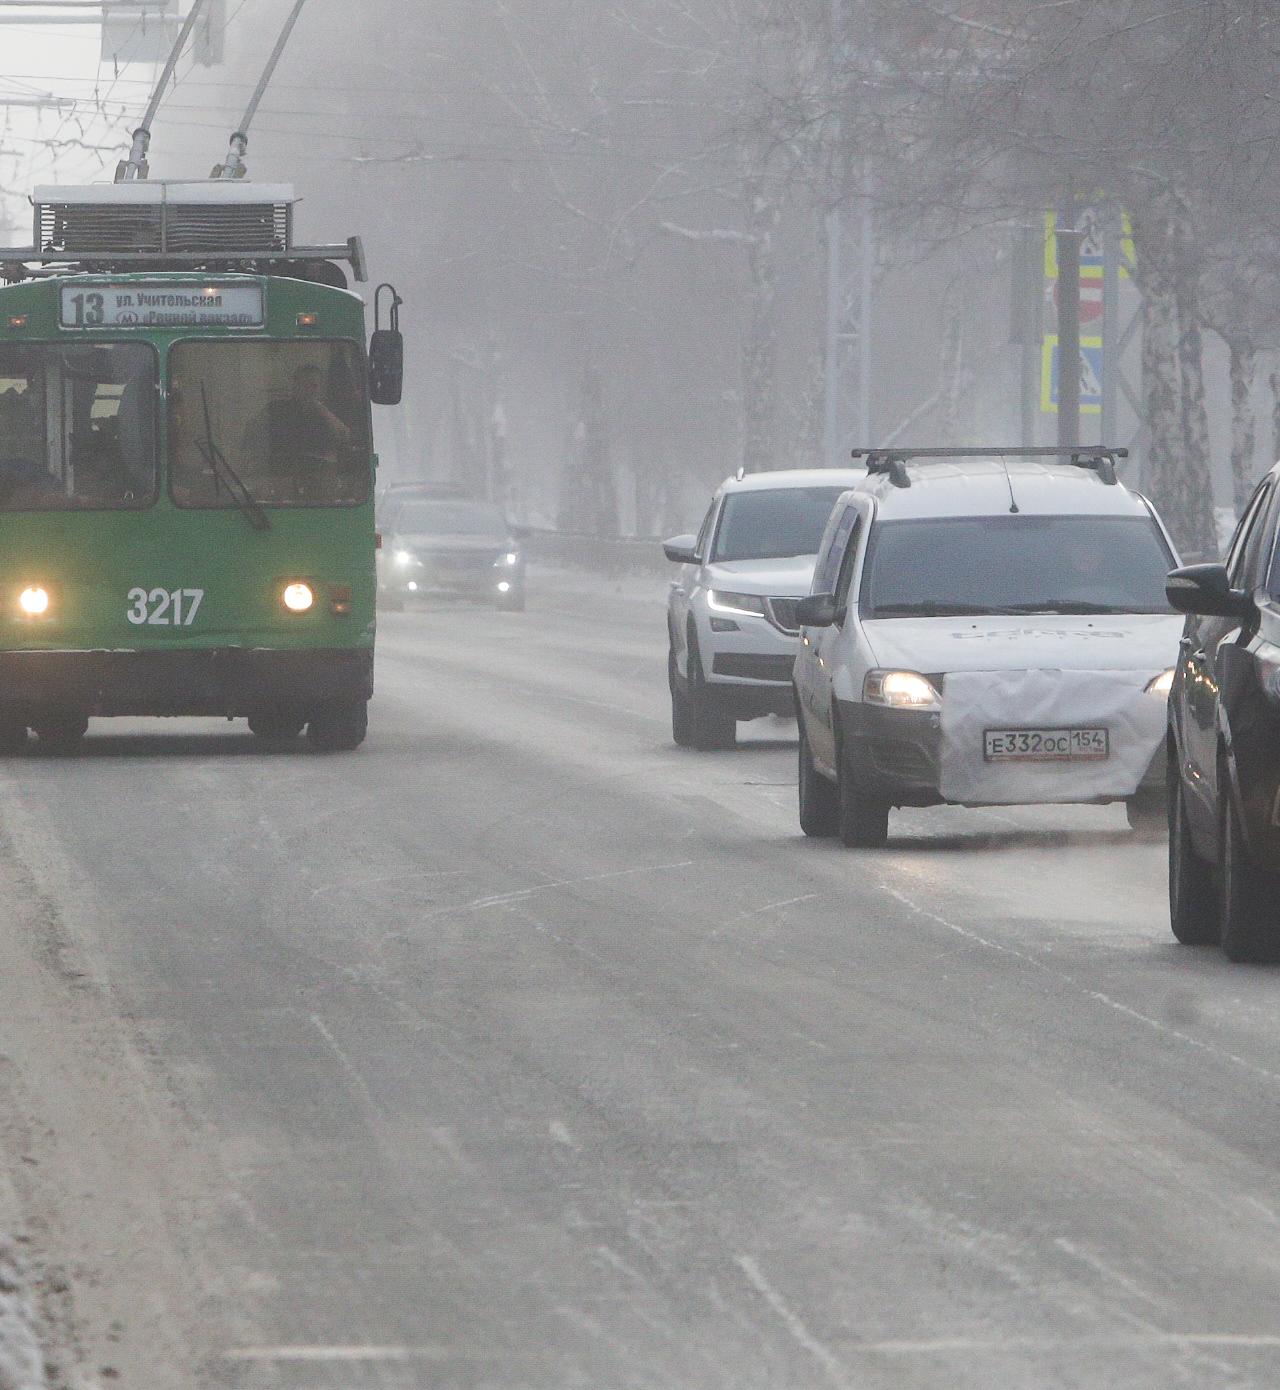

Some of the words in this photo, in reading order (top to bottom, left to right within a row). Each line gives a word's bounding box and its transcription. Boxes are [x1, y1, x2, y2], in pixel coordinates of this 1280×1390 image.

[70, 293, 105, 325] 13
[116, 295, 134, 308] ул.
[137, 293, 223, 307] Учительская
[127, 587, 204, 625] 3217
[992, 733, 1068, 753] Е332ОС
[1072, 732, 1104, 747] 154
